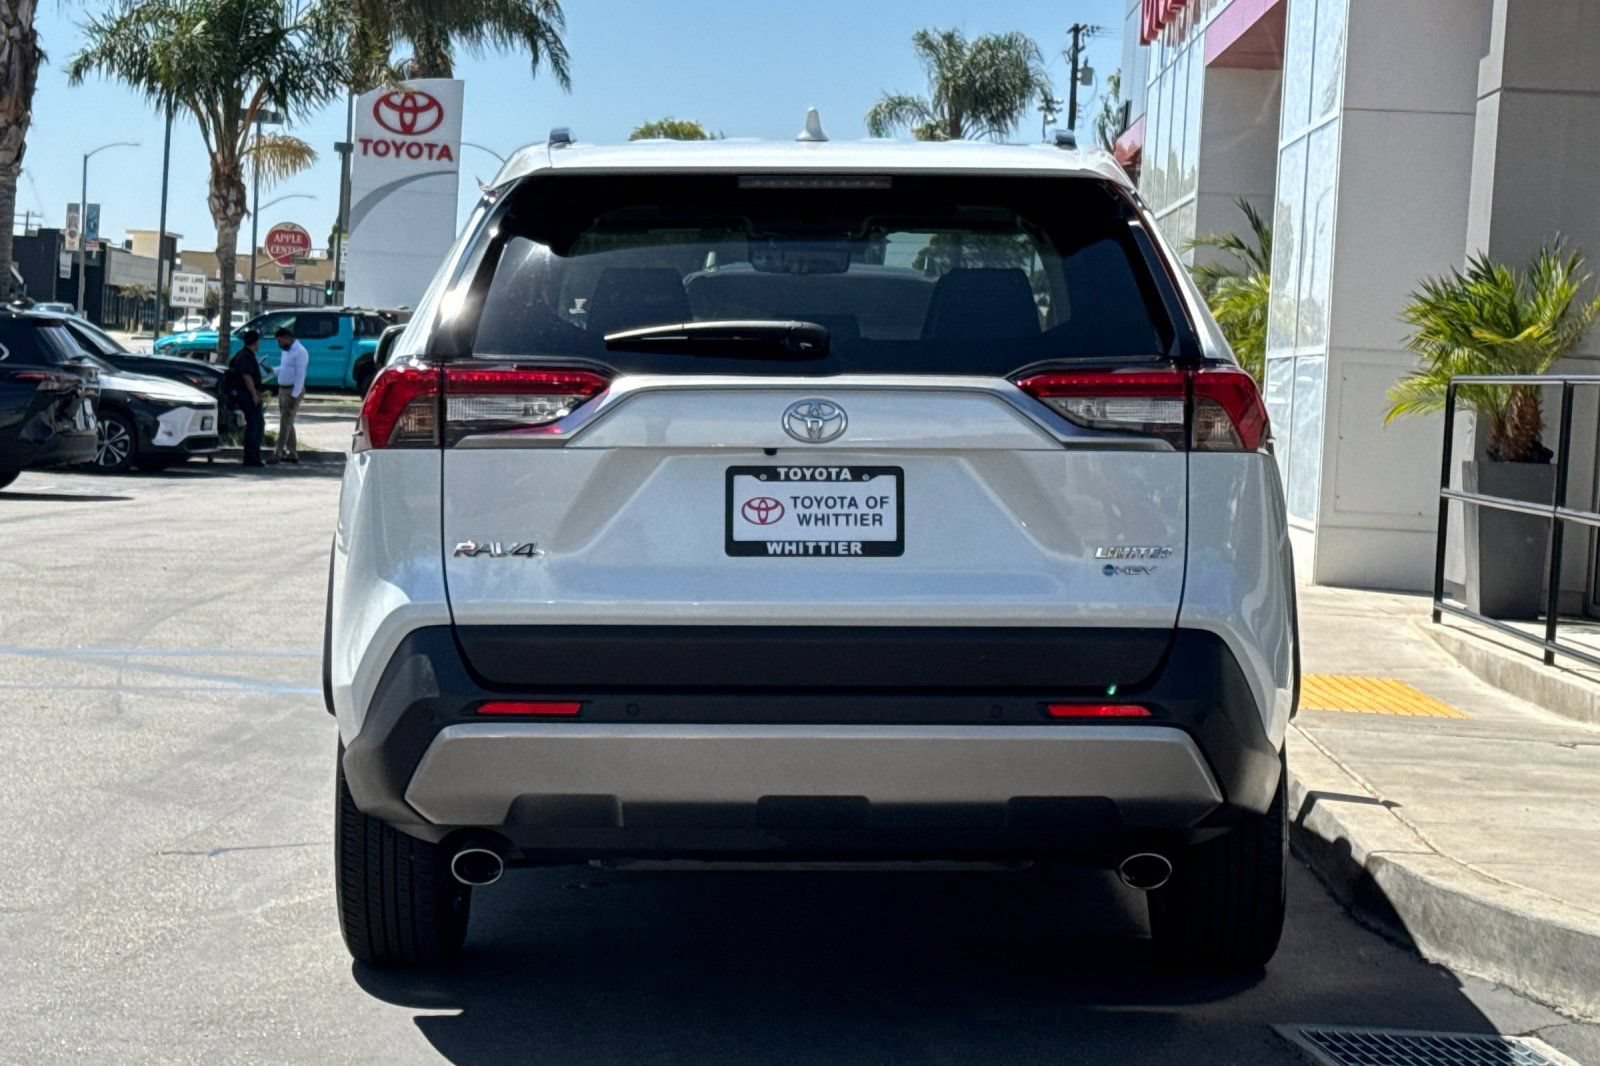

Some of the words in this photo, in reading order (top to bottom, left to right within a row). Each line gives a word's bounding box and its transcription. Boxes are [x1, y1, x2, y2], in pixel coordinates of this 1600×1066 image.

[358, 138, 454, 162] TOYOTA
[273, 234, 303, 244] APPLE
[179, 286, 198, 294] MUST
[777, 467, 852, 481] TOYOTA
[790, 496, 858, 509] TOYOTA
[865, 496, 889, 509] OF
[797, 513, 883, 527] WHITTIER
[453, 540, 538, 558] RAV4
[766, 541, 863, 555] WHITTIER
